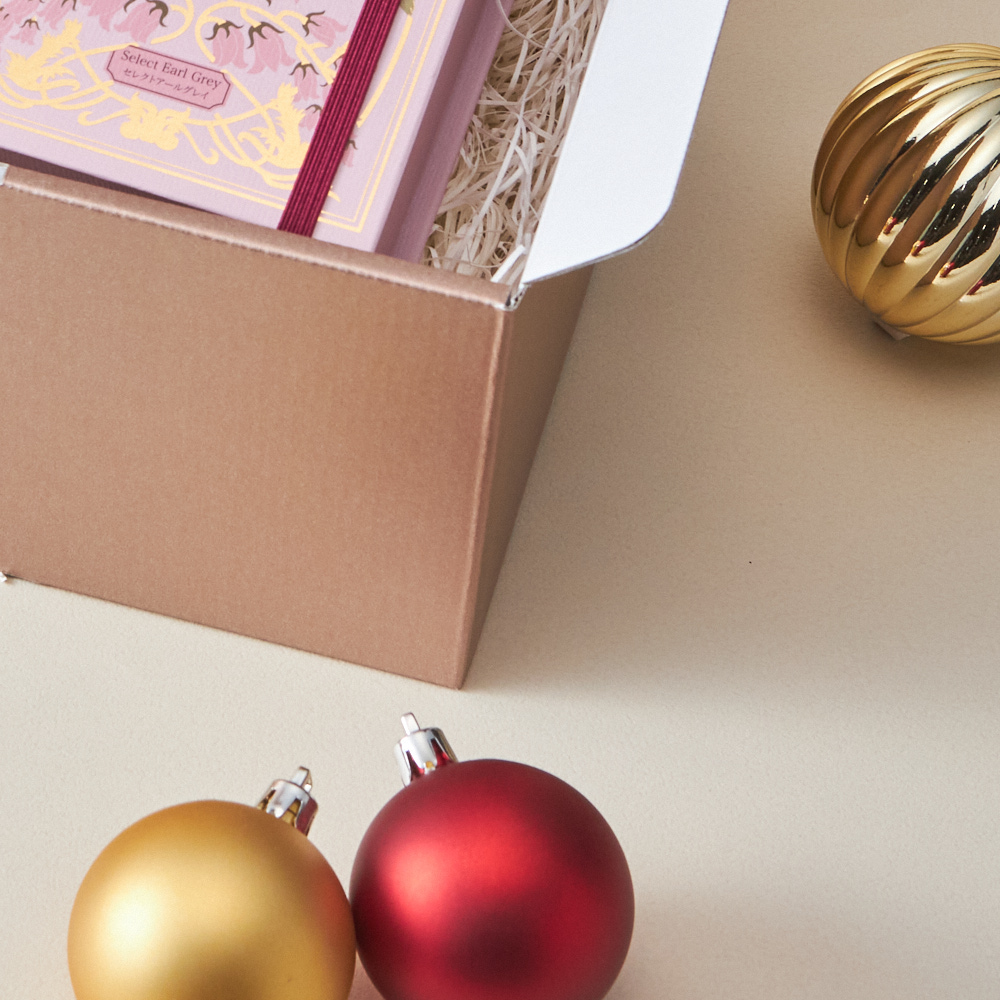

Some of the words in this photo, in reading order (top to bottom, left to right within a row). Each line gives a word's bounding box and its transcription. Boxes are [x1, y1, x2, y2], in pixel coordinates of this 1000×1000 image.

[121, 50, 158, 70] Select
[161, 62, 187, 78] Earl
[191, 71, 222, 90] Grey
[123, 68, 210, 100] セレクトアールグレイ
